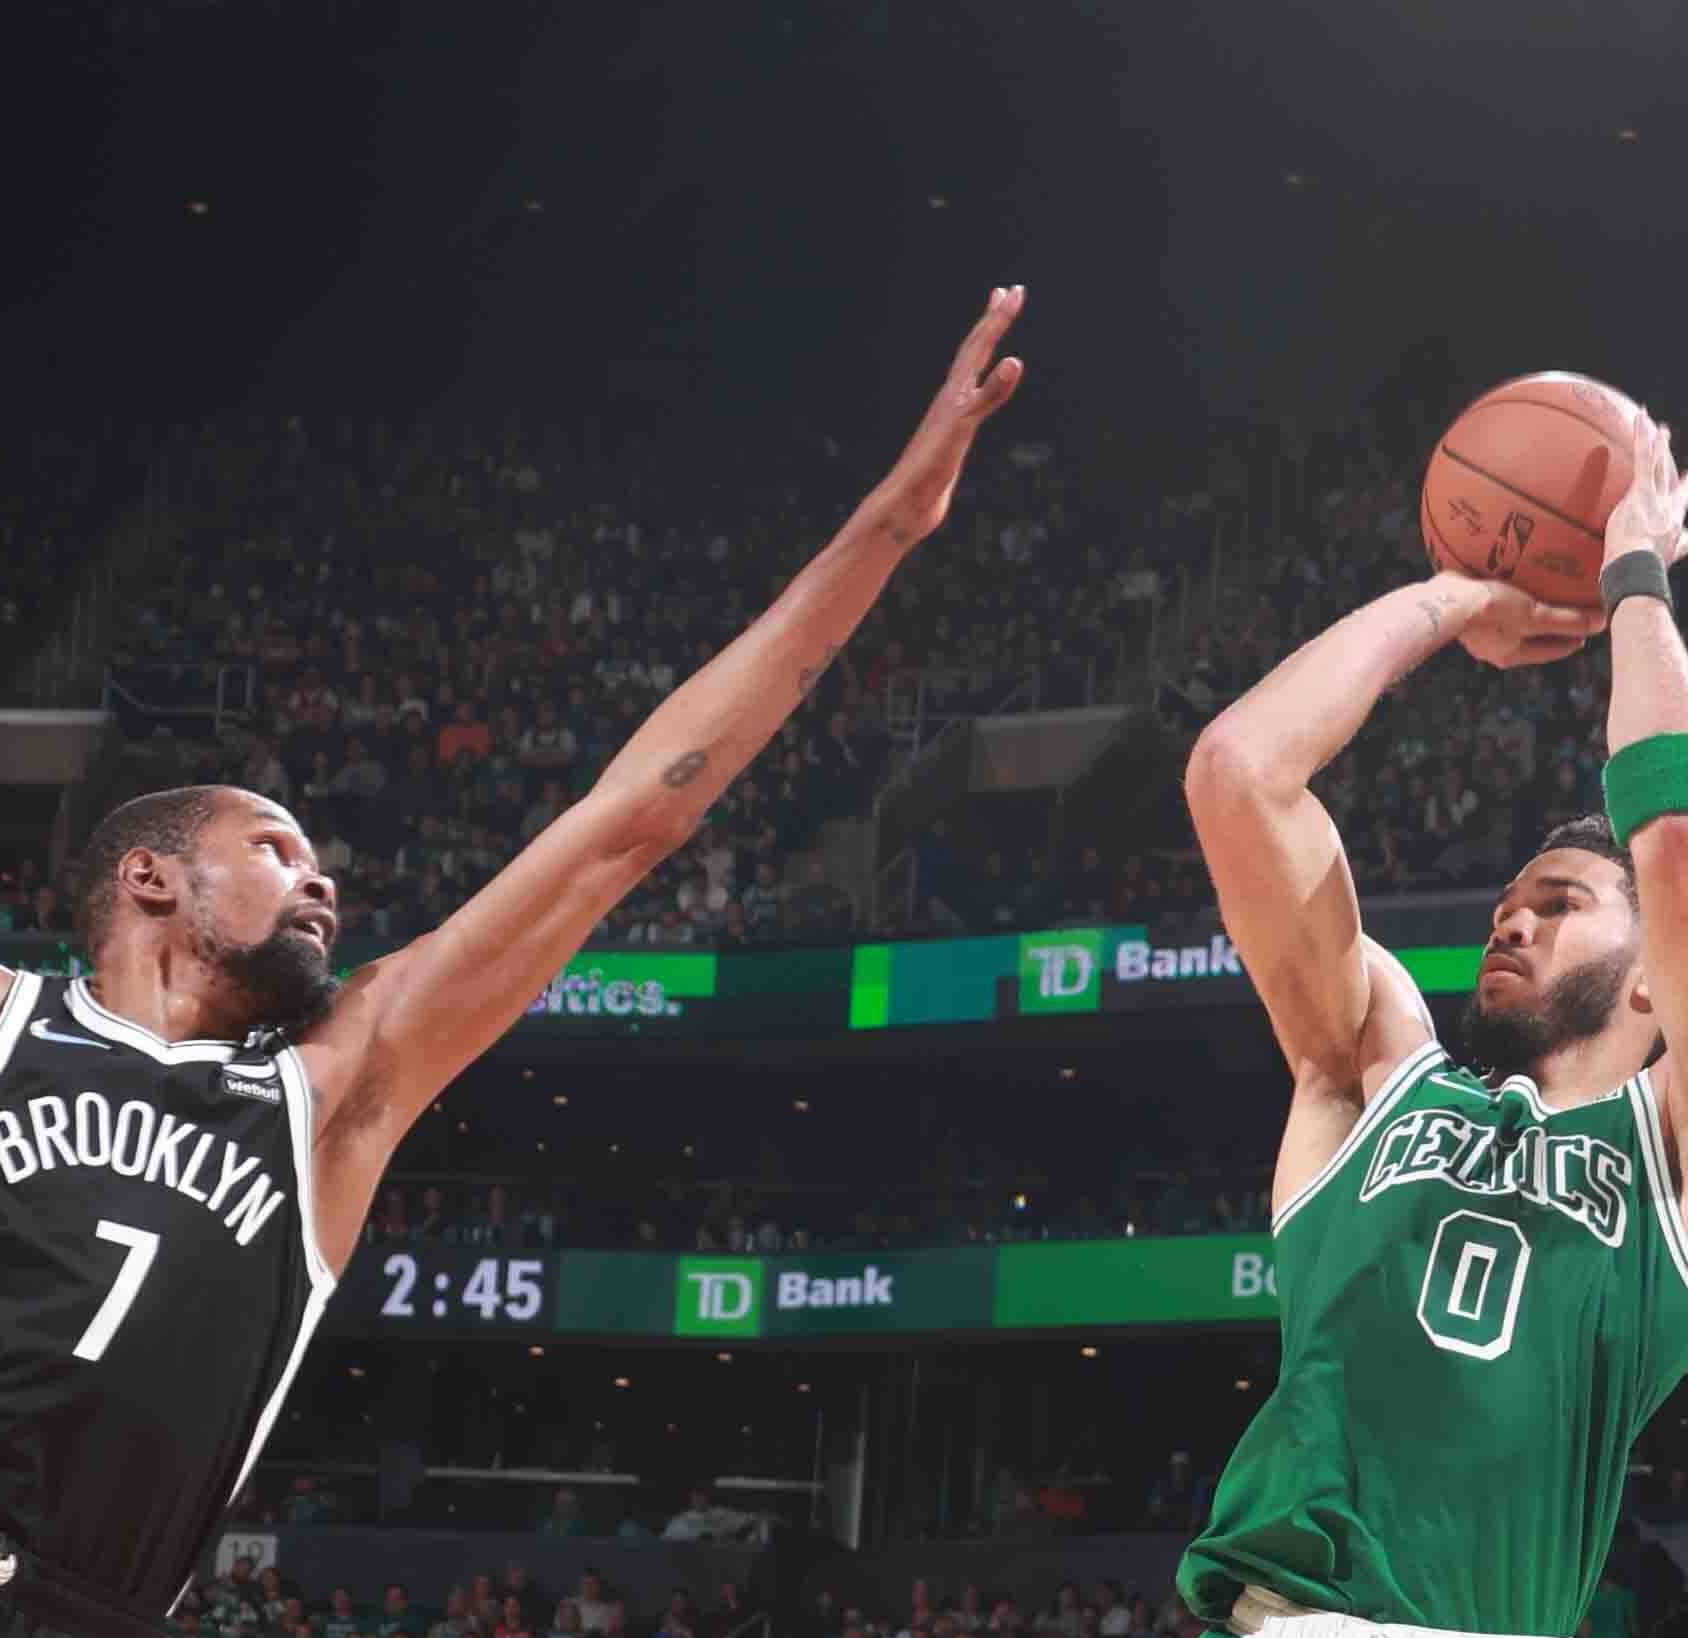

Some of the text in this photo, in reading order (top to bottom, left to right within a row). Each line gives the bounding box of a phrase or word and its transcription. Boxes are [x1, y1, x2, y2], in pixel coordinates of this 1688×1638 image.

[1027, 934, 1241, 997] TD Bank
[1359, 1108, 1633, 1249] CELTICS
[72, 1219, 161, 1362] 7
[380, 1252, 544, 1320] 2:45
[686, 1266, 894, 1321] TD Bank
[1417, 1208, 1532, 1361] 0
